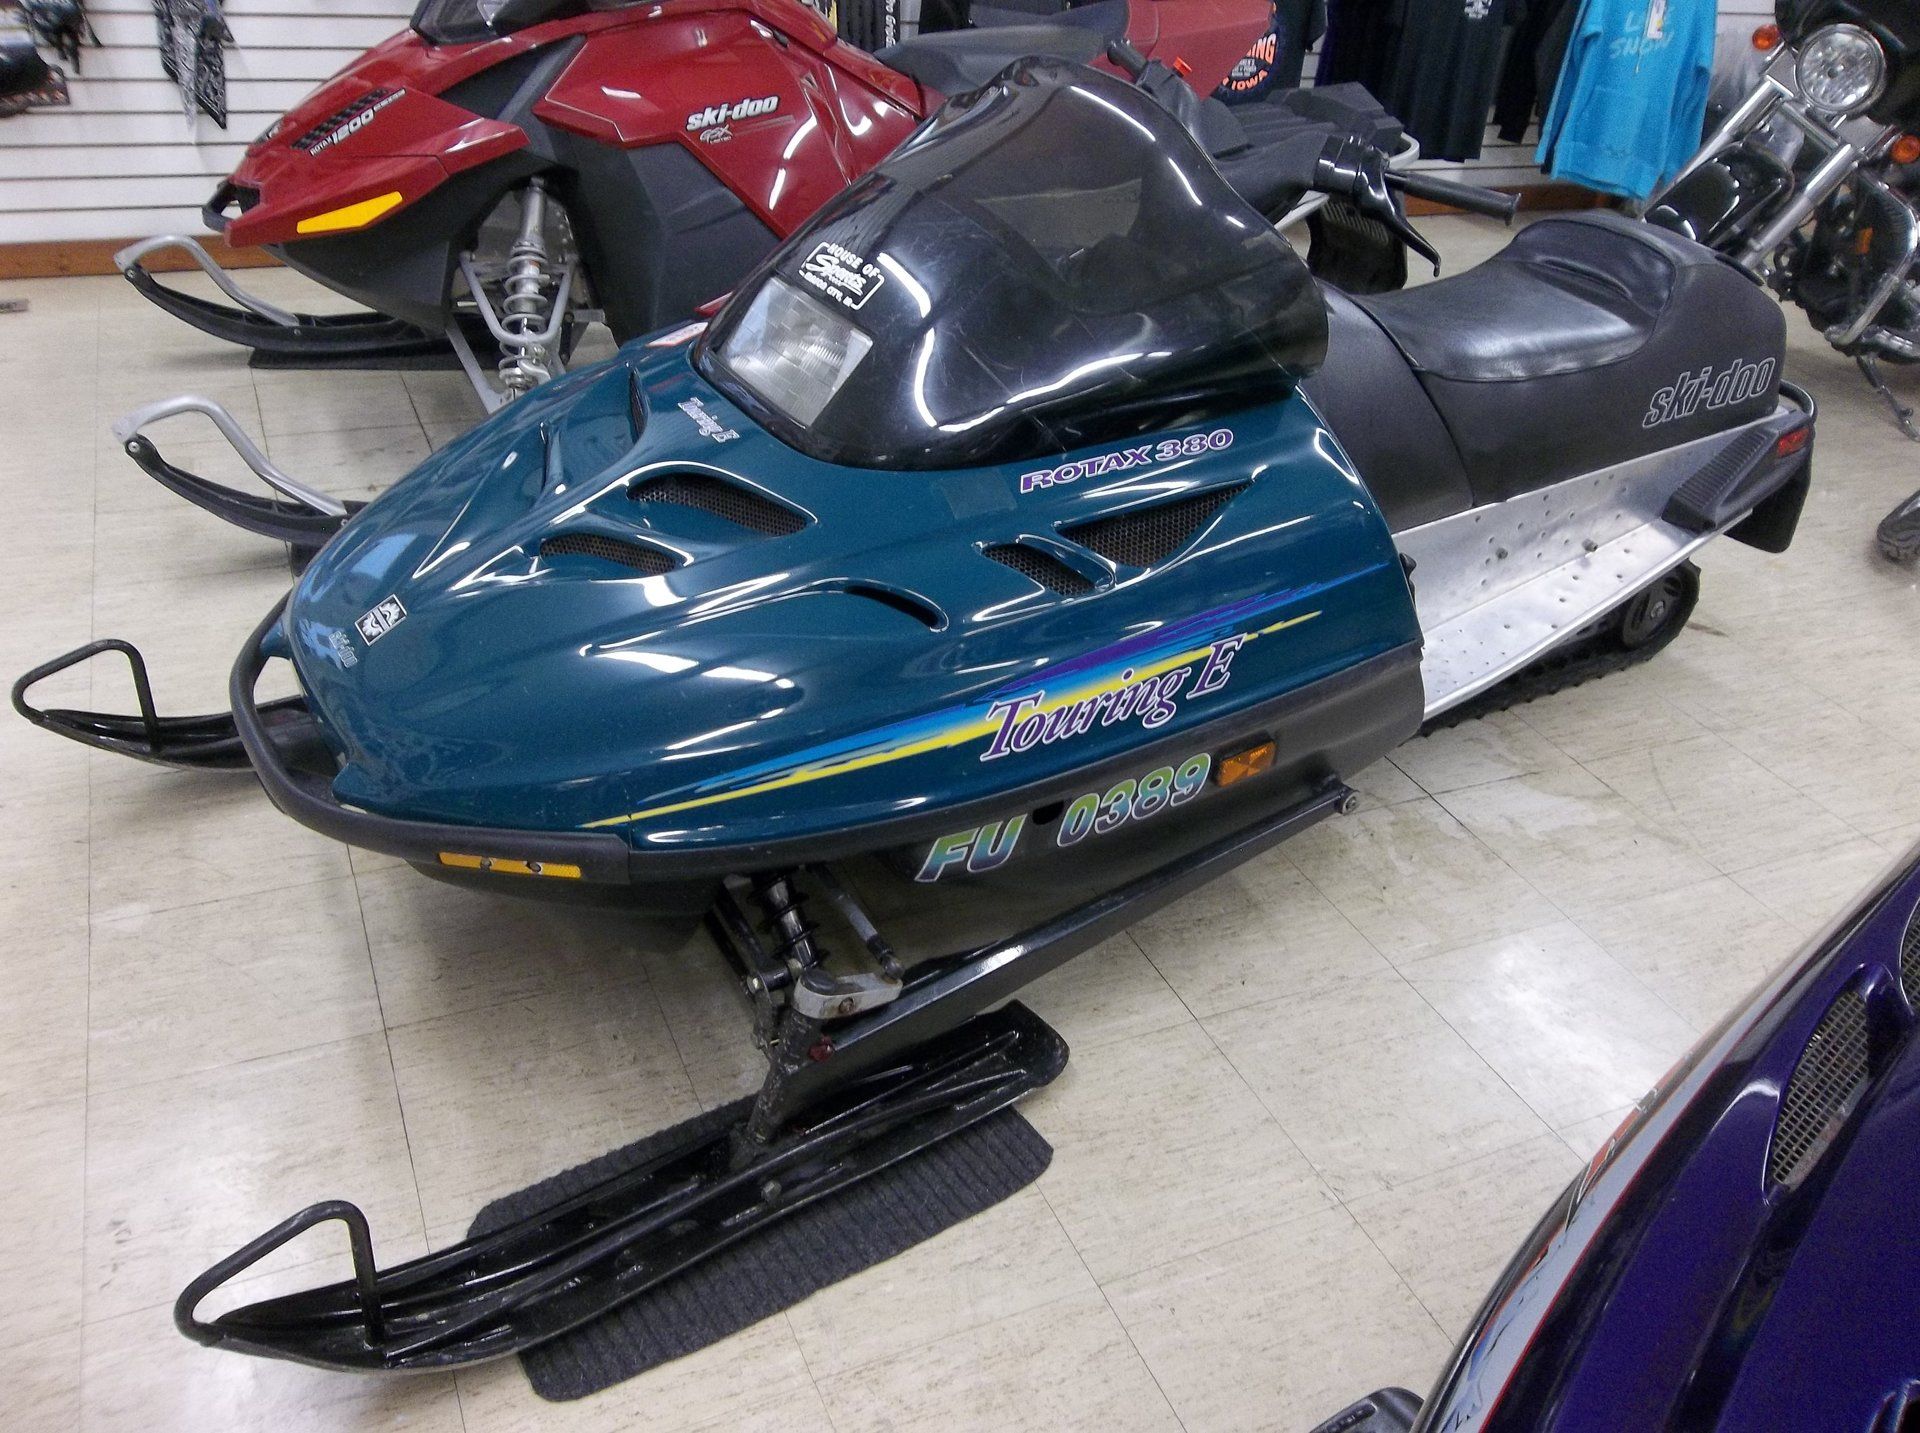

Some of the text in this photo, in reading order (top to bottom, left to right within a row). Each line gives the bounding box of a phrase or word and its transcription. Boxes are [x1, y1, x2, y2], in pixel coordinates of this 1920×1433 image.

[1247, 33, 1277, 65] ING
[1231, 69, 1268, 91] IOWA
[686, 95, 779, 131] ski-doo
[827, 243, 880, 278] HOUSE OF
[1642, 357, 1776, 428] ski-doo
[678, 397, 723, 436] Touring
[1020, 428, 1234, 494] ROTAX 380
[979, 632, 1248, 762] Touring E
[914, 753, 1212, 882] FU 0389
